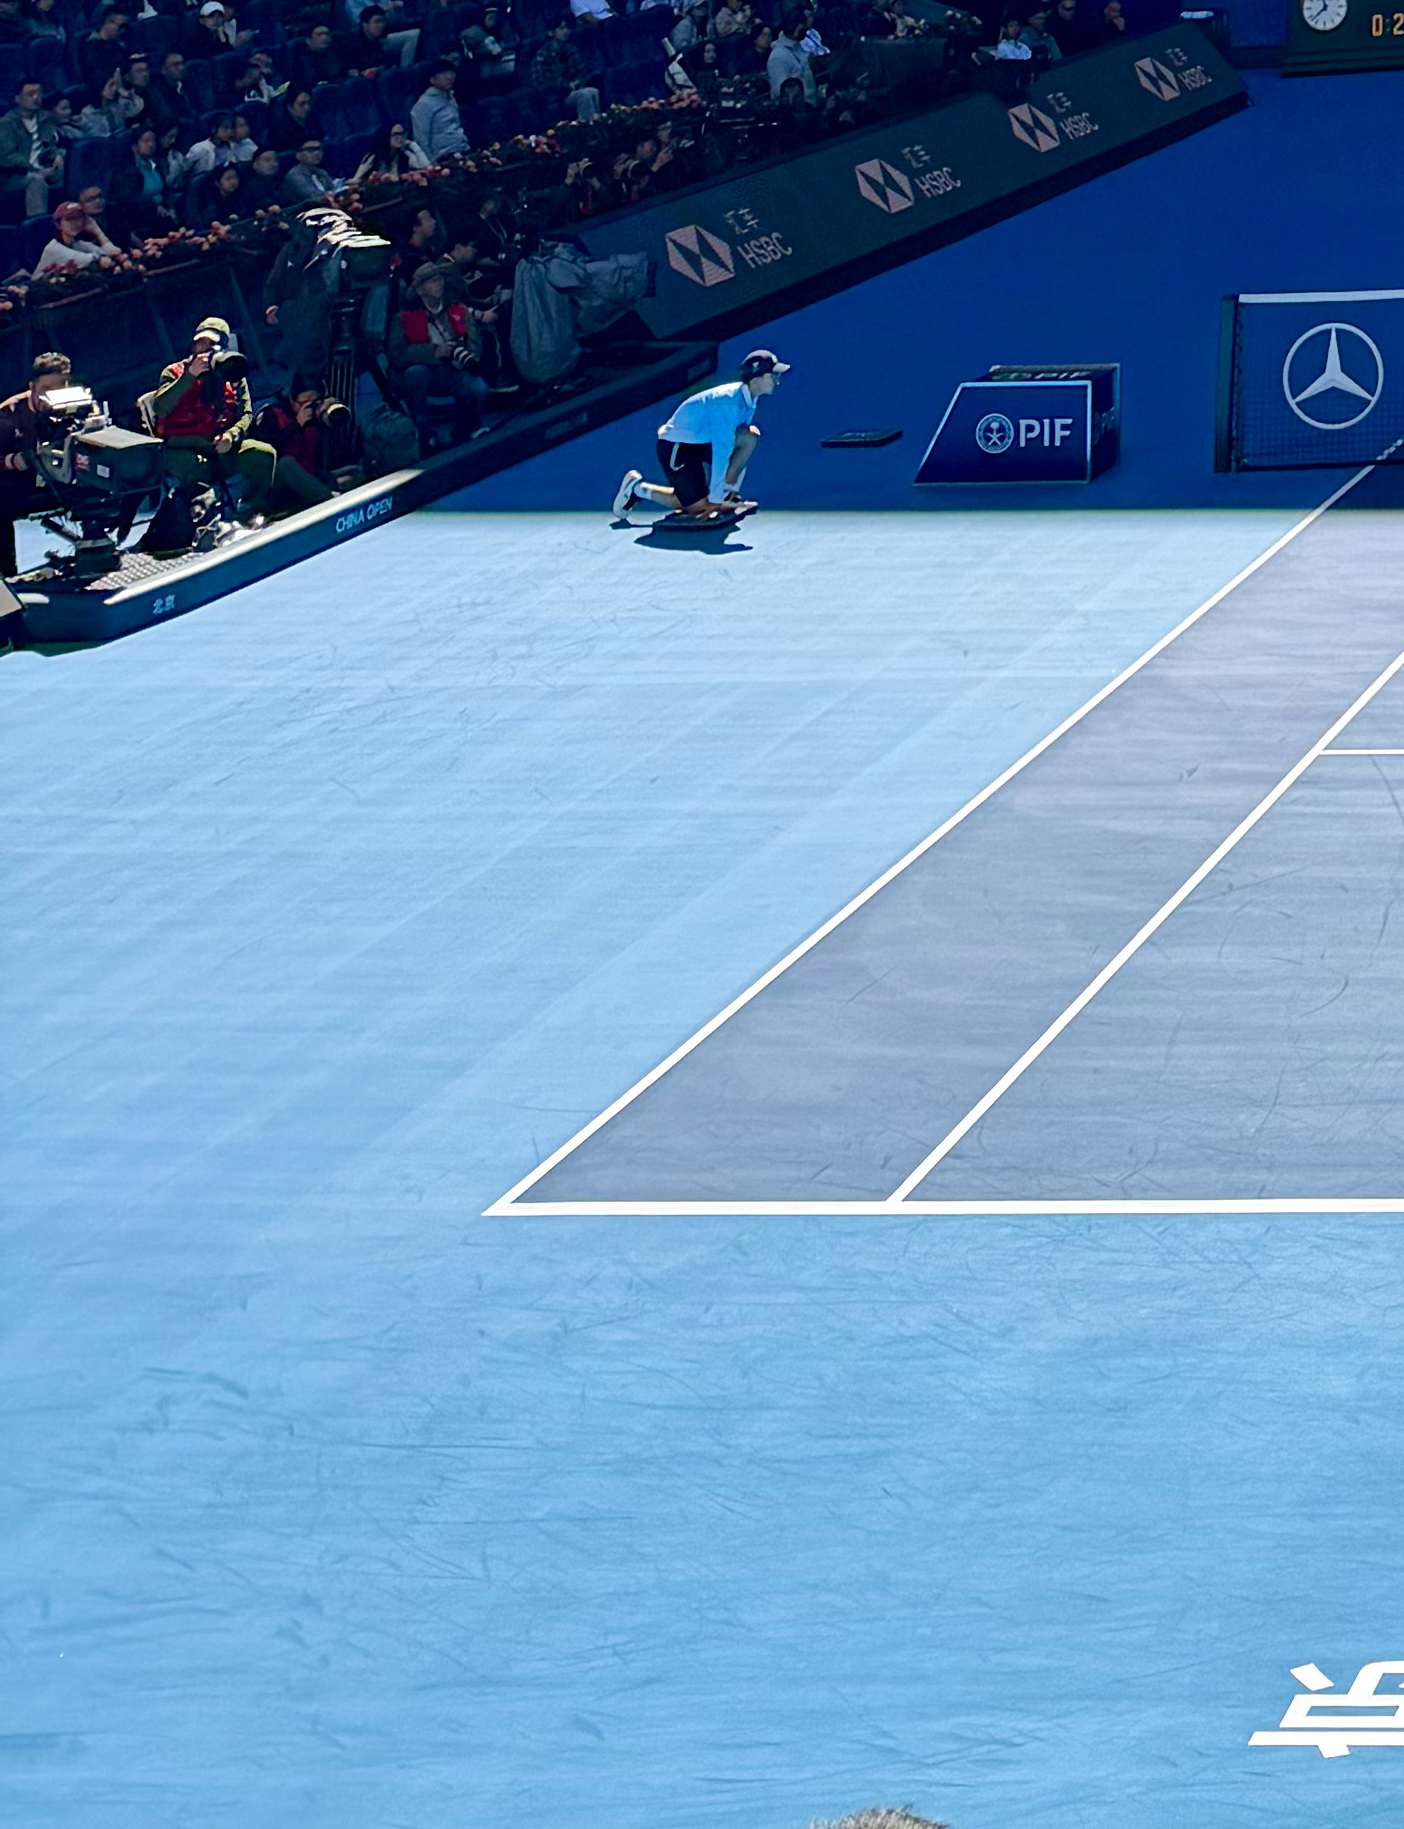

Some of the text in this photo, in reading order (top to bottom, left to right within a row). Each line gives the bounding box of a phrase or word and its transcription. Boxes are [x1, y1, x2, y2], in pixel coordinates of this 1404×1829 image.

[914, 167, 962, 199] HSBC
[737, 231, 793, 269] HSBC
[1019, 418, 1073, 448] PIF
[336, 508, 364, 533] CHINA
